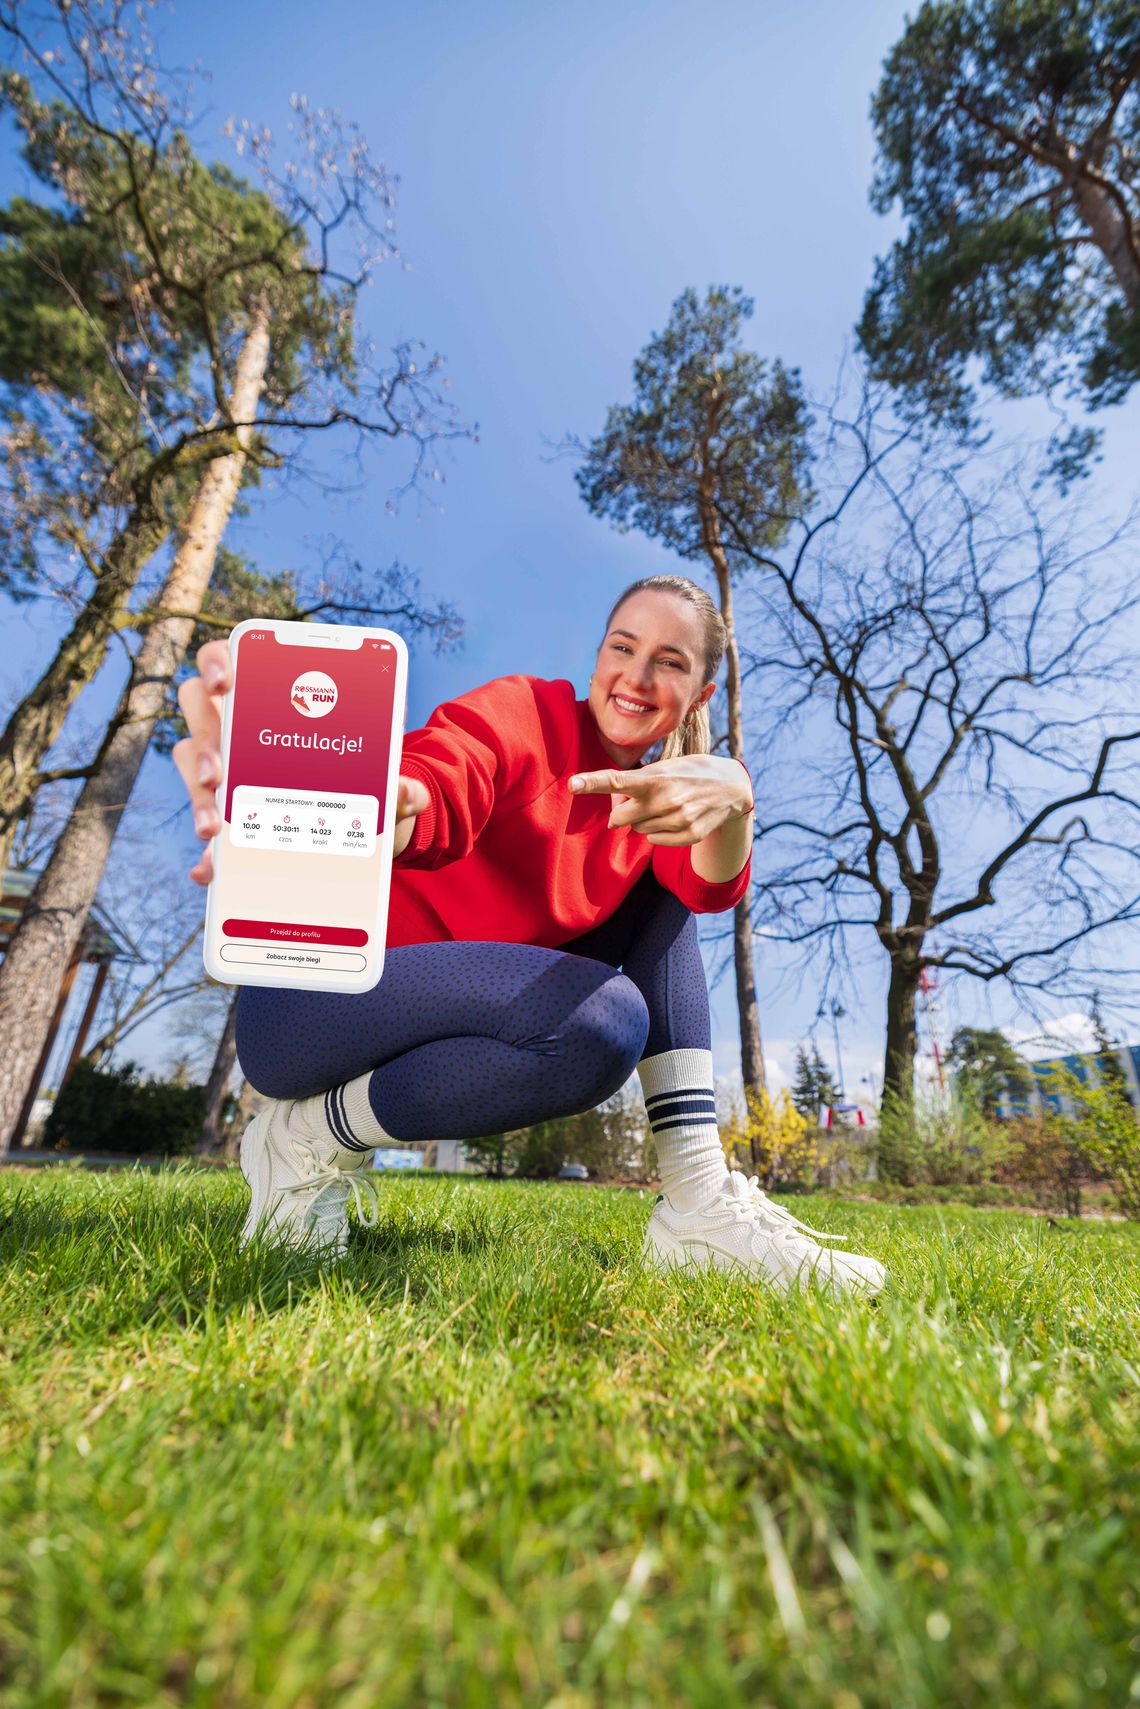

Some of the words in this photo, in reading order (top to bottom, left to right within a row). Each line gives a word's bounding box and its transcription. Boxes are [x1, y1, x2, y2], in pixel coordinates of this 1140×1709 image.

[250, 633, 265, 641] 9:41
[294, 685, 336, 694] ROSSMANN
[312, 694, 334, 703] RUN
[259, 729, 363, 755] Gratulacje!
[317, 801, 346, 809] 0000000
[273, 825, 300, 833] 50:30:11
[342, 841, 367, 849] min/km
[270, 928, 291, 936] Przejdź
[306, 956, 321, 964] biegi
